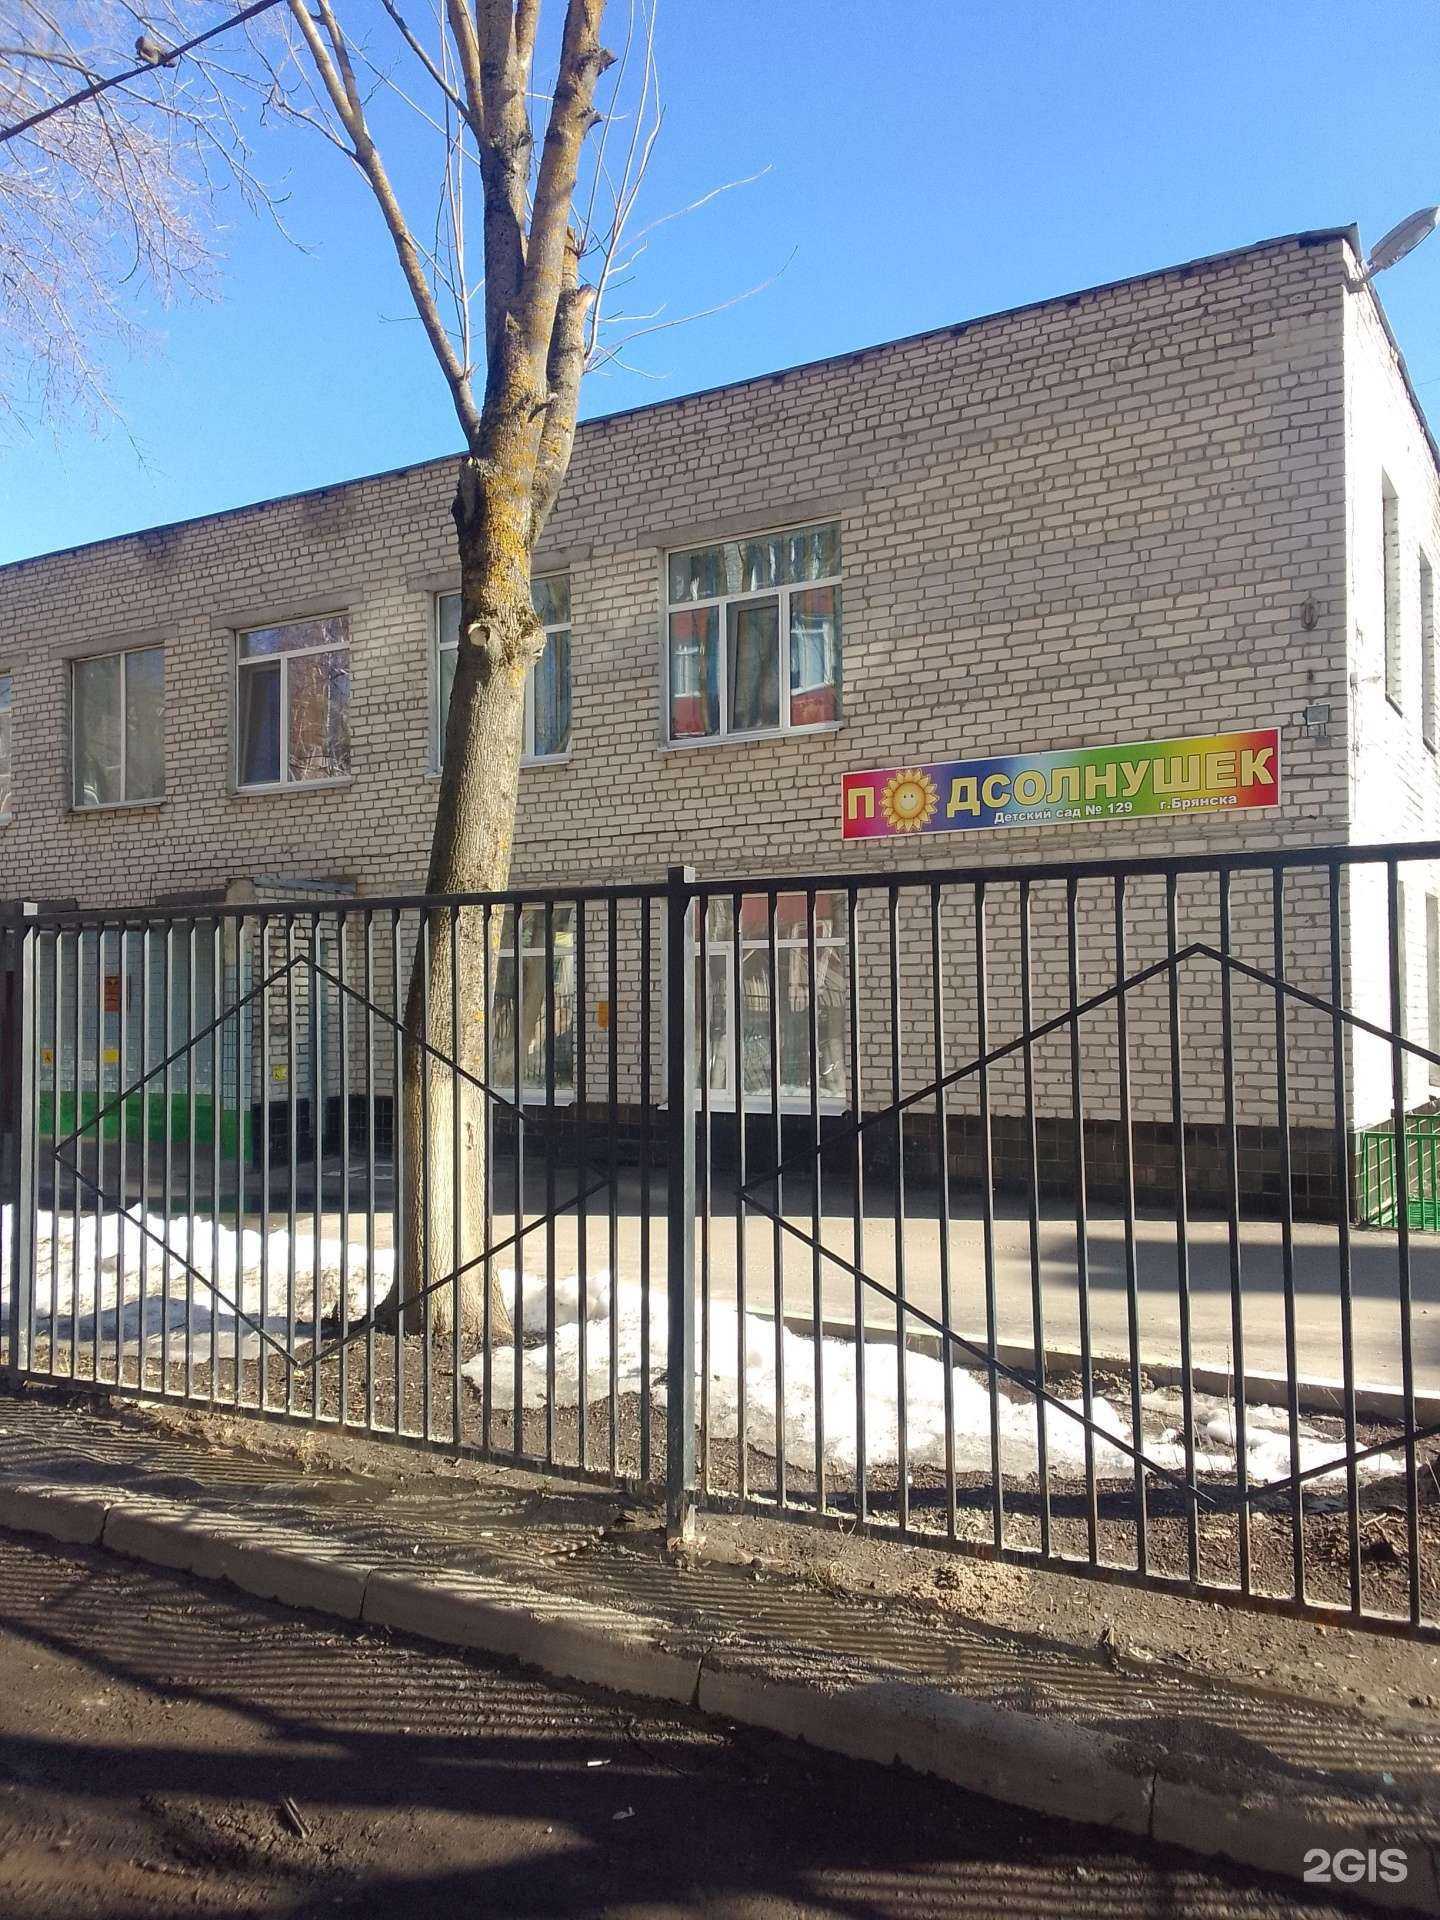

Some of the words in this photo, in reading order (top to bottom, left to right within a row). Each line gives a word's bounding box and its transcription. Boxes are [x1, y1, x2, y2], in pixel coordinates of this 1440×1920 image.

[994, 809, 1052, 824] Детский
[1056, 807, 1081, 818] сад
[1085, 804, 1103, 816] №
[1107, 802, 1133, 814] 129
[1159, 795, 1238, 811] г.Брянска
